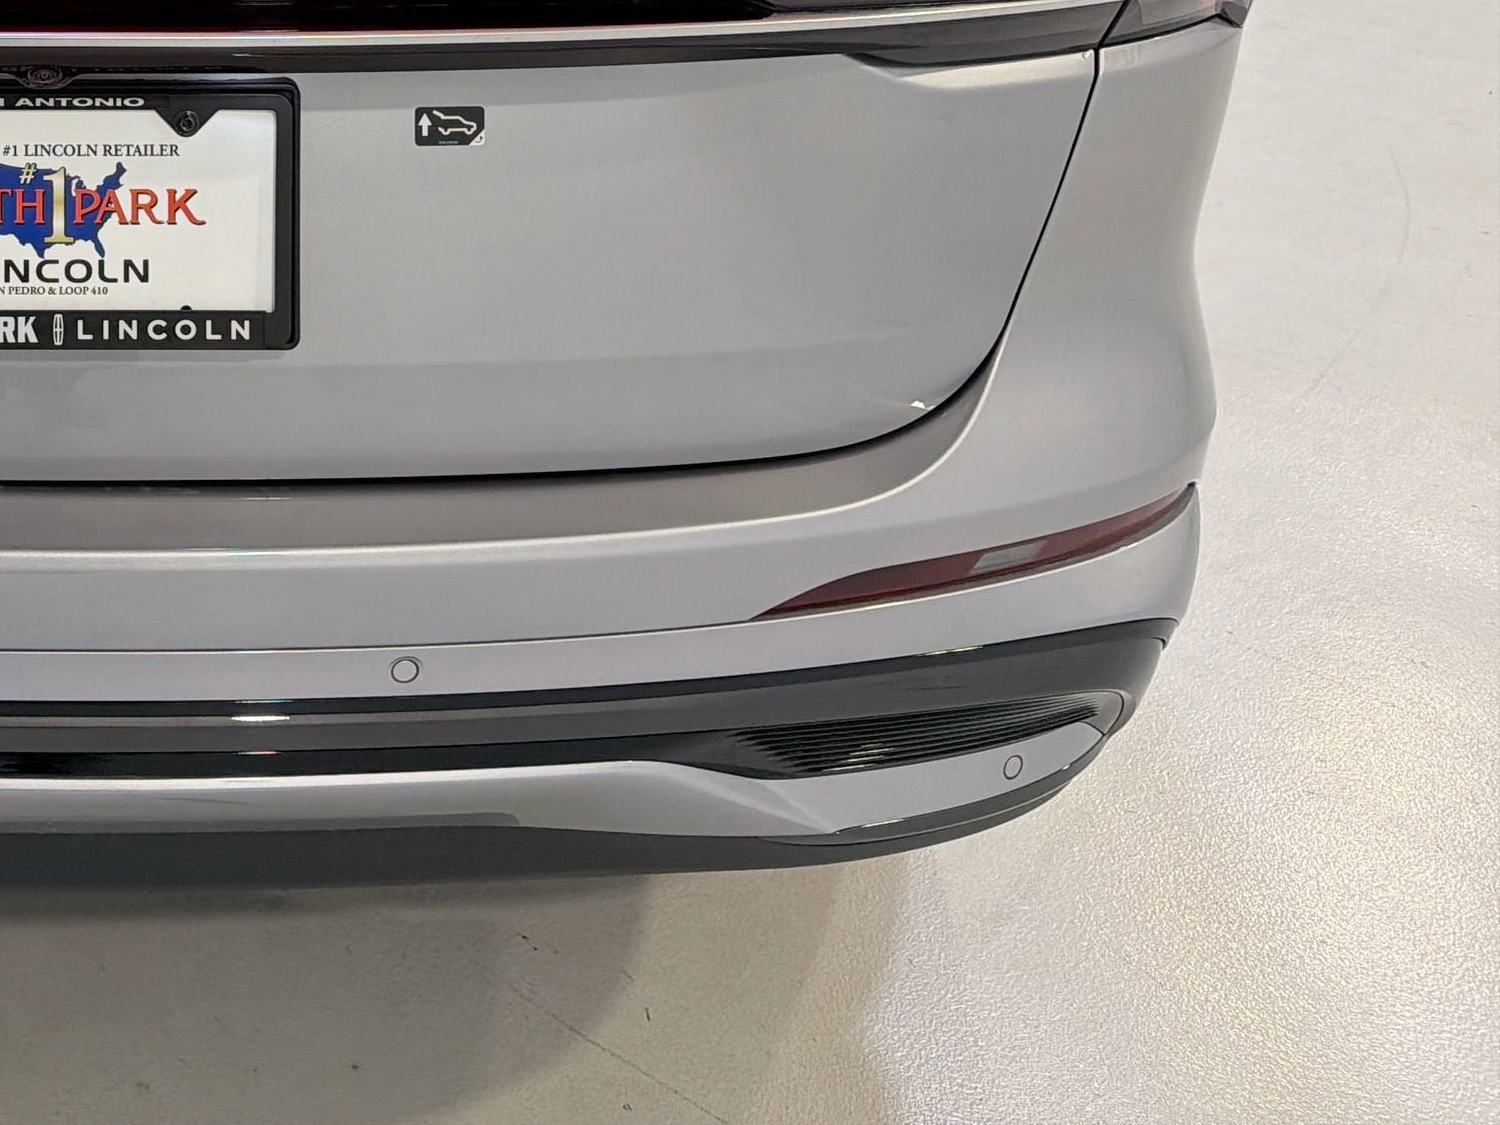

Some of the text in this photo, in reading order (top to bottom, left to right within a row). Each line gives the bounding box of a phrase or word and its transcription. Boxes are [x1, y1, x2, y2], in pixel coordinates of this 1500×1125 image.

[15, 97, 145, 107] ANTONIO
[3, 144, 19, 157] #1
[24, 143, 98, 157] LINCOLN
[102, 143, 180, 157] RETAILER
[74, 188, 206, 226] PARK
[8, 286, 45, 295] PEDRO
[48, 286, 57, 295] &
[59, 286, 89, 295] LOOP
[91, 286, 108, 295] 410
[77, 319, 250, 340] LINCOLN
